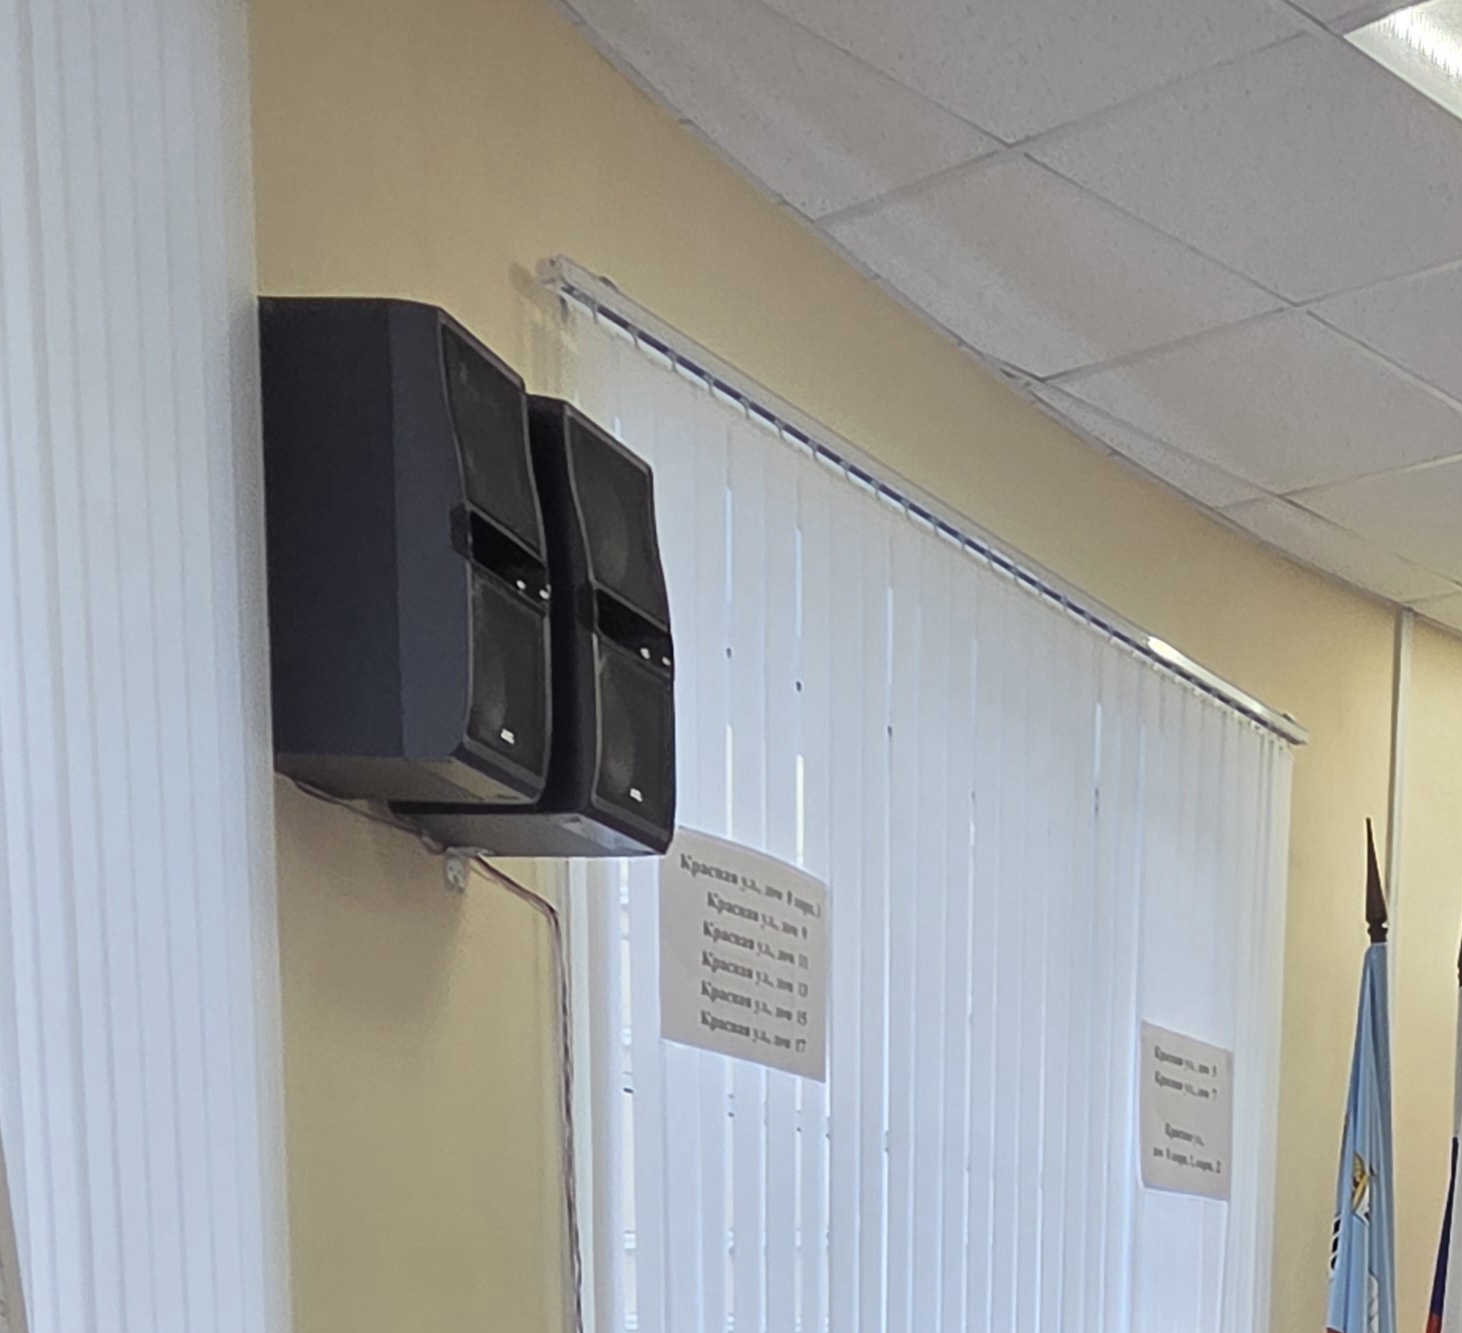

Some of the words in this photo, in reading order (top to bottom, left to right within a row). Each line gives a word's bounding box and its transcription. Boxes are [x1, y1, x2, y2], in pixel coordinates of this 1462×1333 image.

[680, 853, 738, 885] Красная
[707, 891, 758, 922] Красная
[703, 920, 754, 950] Красная
[702, 950, 753, 979] Красная
[701, 980, 751, 1008] Красная
[700, 1009, 750, 1037] Красная
